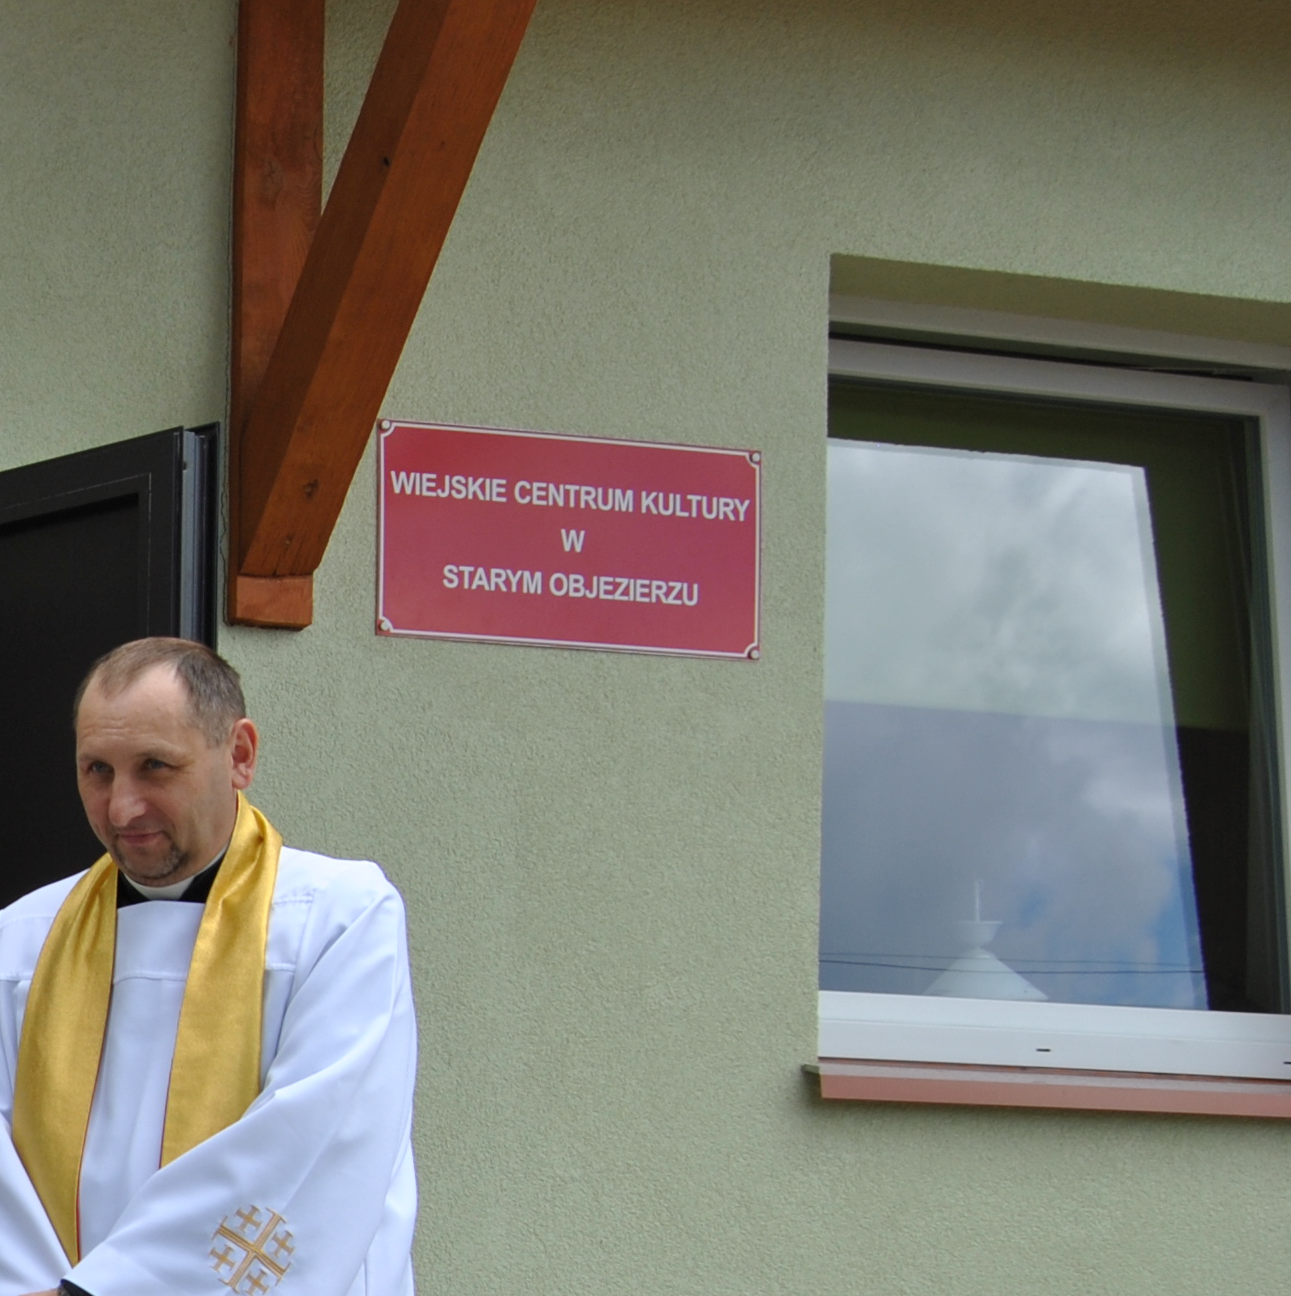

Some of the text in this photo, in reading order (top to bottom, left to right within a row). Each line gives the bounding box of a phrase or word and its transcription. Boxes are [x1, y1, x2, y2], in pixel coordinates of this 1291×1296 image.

[390, 470, 750, 522] WIEJSKIE CENTRUM KULTURY
[560, 528, 585, 553] W
[442, 564, 699, 606] STARYM OBJEZIERZU
